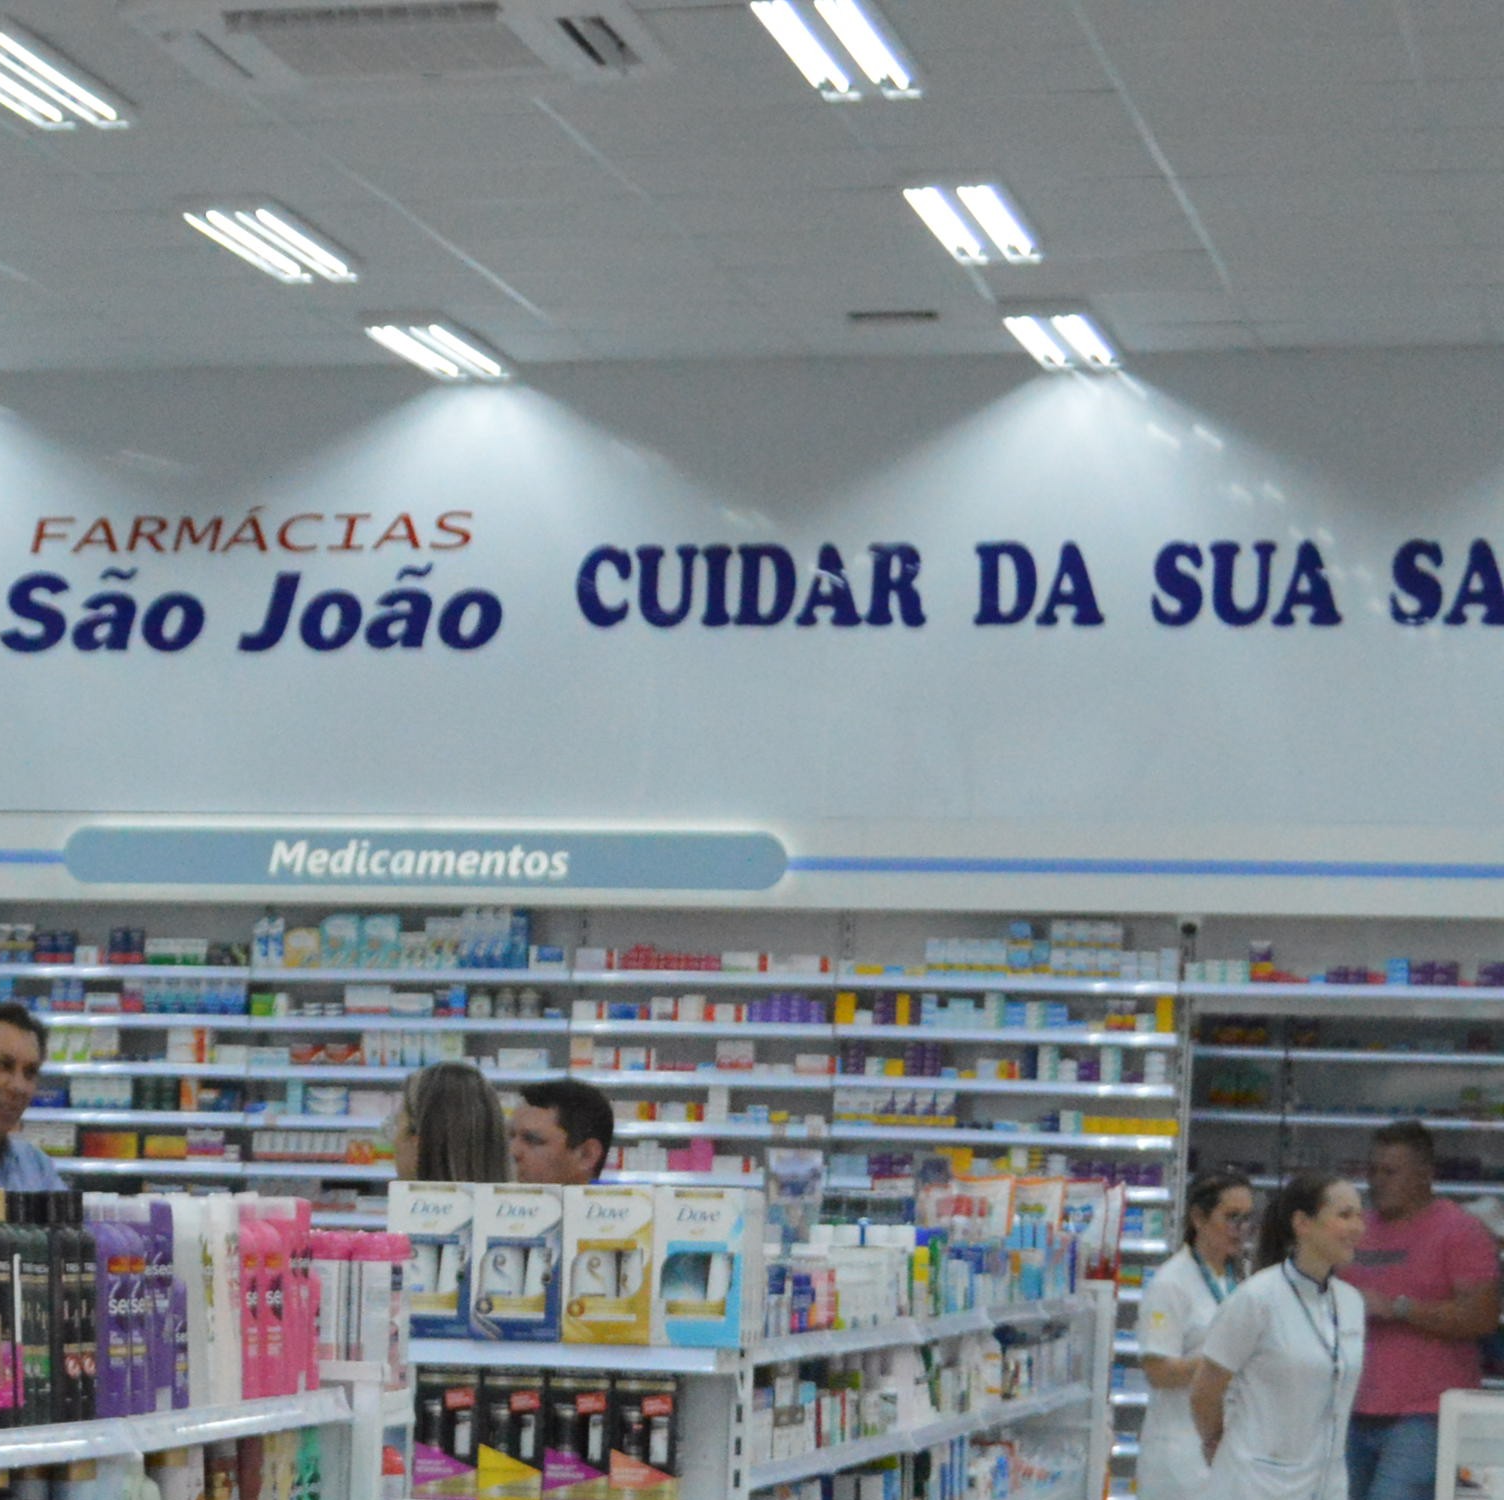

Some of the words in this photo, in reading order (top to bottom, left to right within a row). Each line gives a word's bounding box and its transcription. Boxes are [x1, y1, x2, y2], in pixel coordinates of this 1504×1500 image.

[31, 506, 473, 553] FARMÁCIAS
[575, 542, 927, 627] CUIDAR
[974, 542, 1105, 627] DA
[1152, 540, 1343, 627] SUA
[0, 567, 205, 653] São
[239, 564, 504, 652] João
[269, 840, 569, 880] Medicamentos
[411, 1201, 452, 1215] Dove
[497, 1202, 538, 1217] Dove
[586, 1203, 629, 1219] Dove
[677, 1206, 720, 1222] Dove
